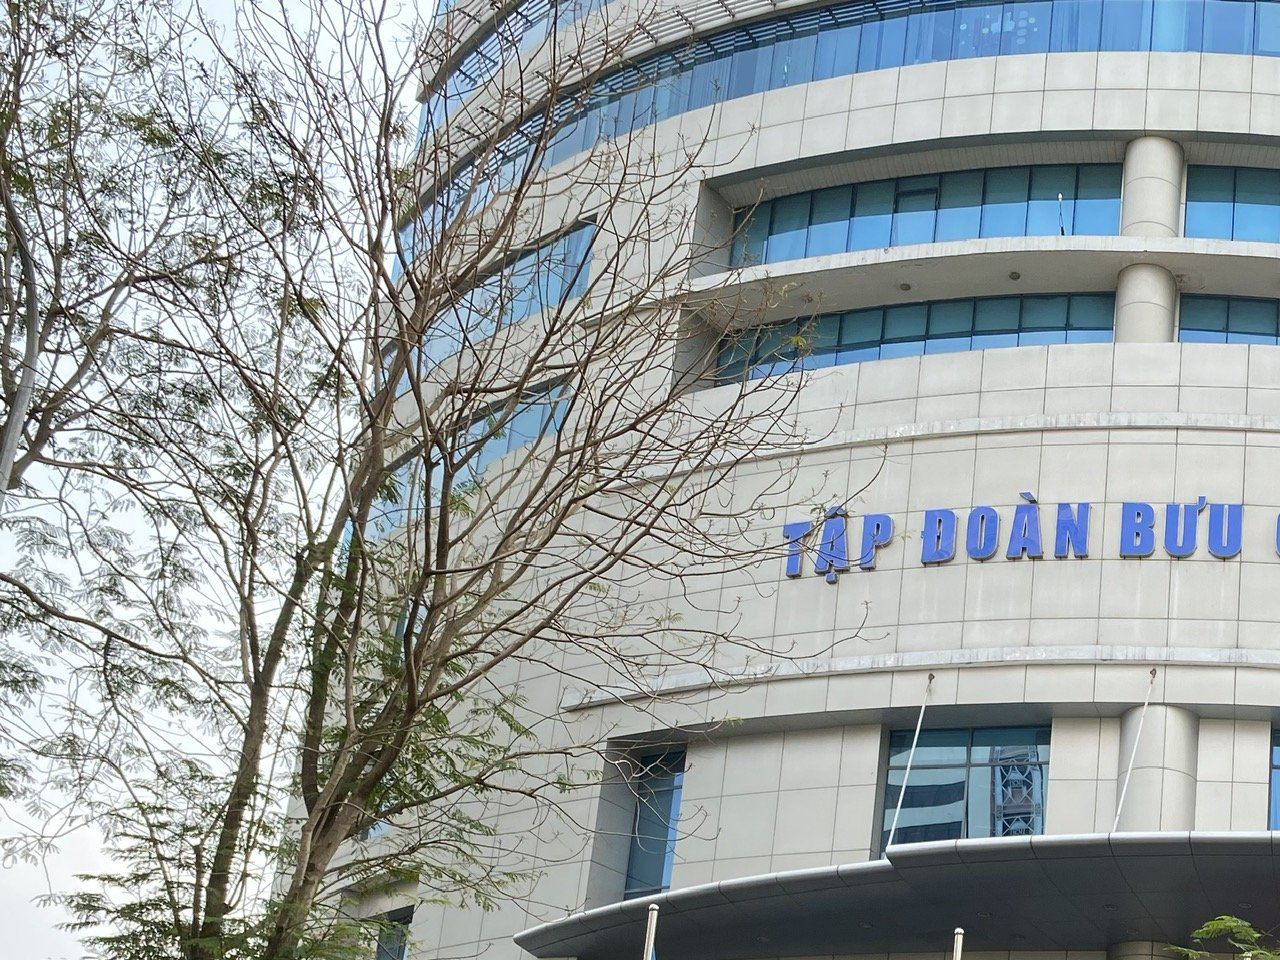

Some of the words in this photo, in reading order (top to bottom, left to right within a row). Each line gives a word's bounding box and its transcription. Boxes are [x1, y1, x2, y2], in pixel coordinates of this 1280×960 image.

[782, 506, 894, 585] TẬP
[920, 491, 1092, 565] ĐOÀN
[1119, 495, 1245, 559] BƯU
